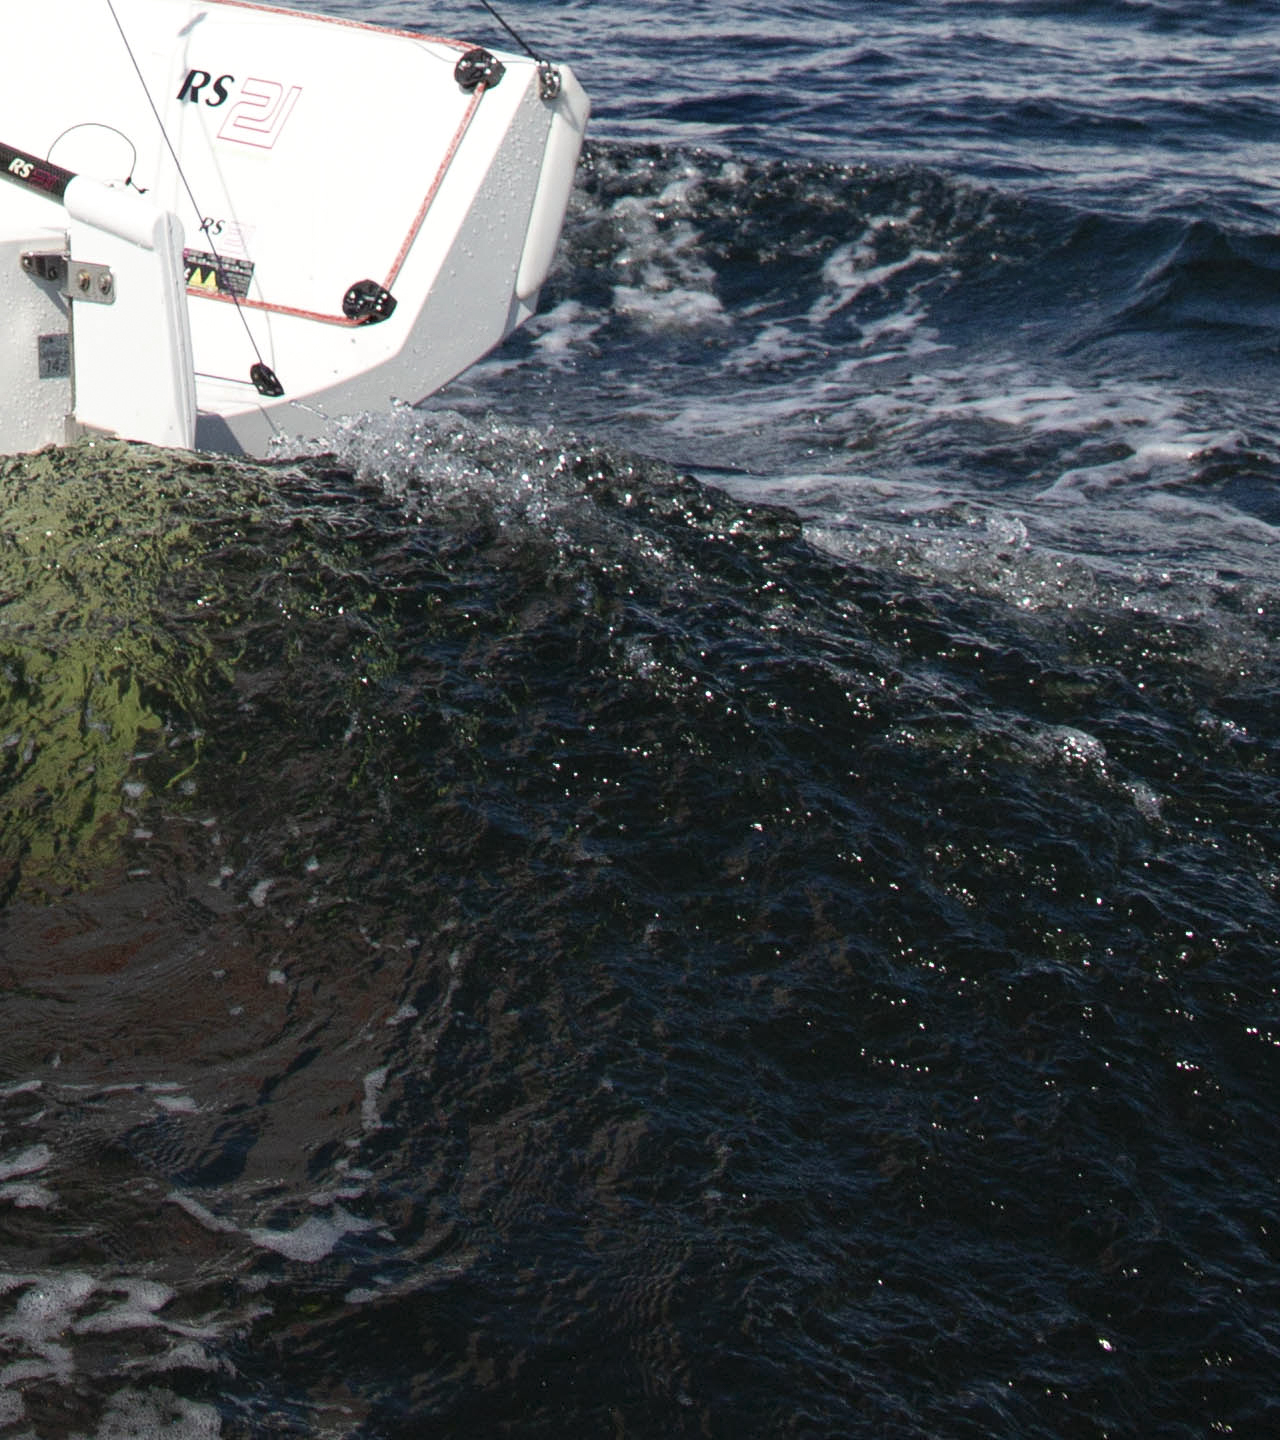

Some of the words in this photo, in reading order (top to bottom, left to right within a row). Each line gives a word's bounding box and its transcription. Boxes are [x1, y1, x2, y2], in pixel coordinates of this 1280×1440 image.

[176, 69, 235, 107] RS
[216, 77, 302, 149] 21
[8, 158, 34, 178] RS
[199, 217, 226, 236] RS
